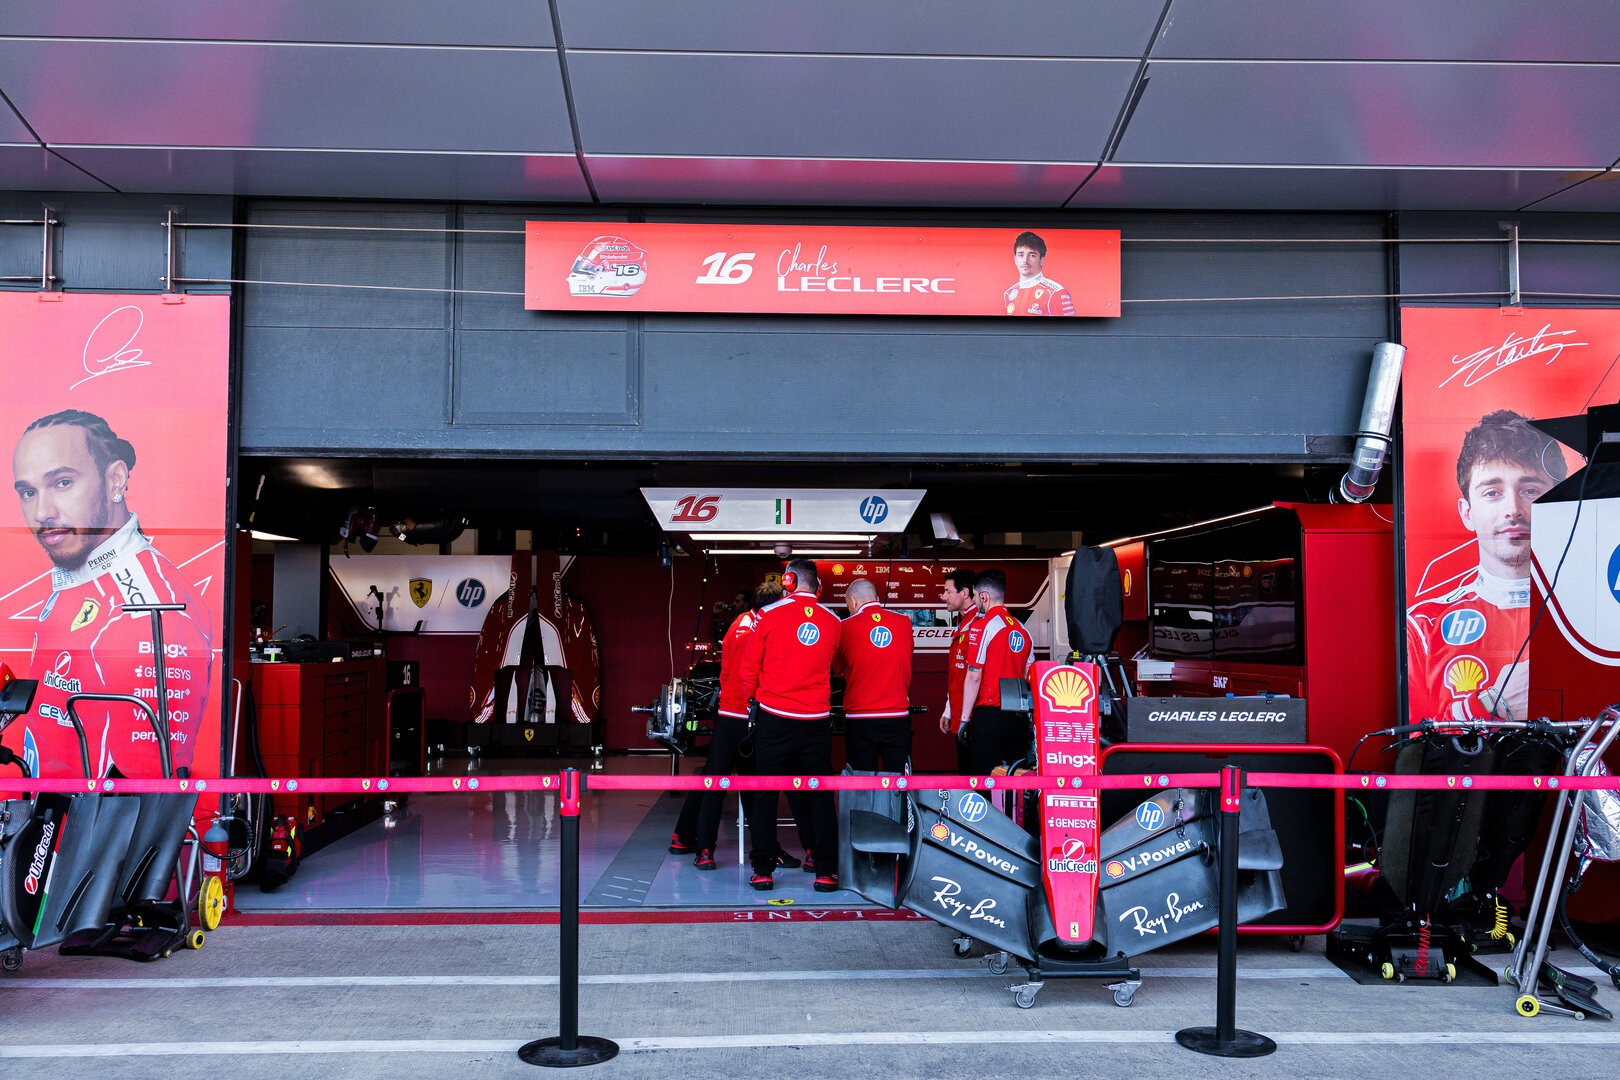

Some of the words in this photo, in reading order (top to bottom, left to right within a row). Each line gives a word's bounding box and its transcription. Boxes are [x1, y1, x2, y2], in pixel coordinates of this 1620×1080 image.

[695, 252, 757, 285] 16
[777, 241, 839, 277] Charles
[578, 284, 595, 293] IBM
[777, 276, 956, 293] LECLERC
[669, 493, 723, 524] 16
[862, 496, 887, 525] hp
[87, 548, 117, 568] PERONI
[875, 566, 890, 574] IBM
[459, 578, 483, 609] hp
[798, 623, 819, 646] hp
[871, 626, 890, 648] hp
[1446, 611, 1481, 646] hp
[1009, 630, 1024, 652] hp
[43, 670, 81, 693] UniCredit
[144, 666, 191, 681] GEESYS
[402, 664, 411, 685] 16
[1148, 711, 1217, 723] CHARLES
[1219, 711, 1287, 723] LECLERC
[131, 731, 188, 745] perpxity
[1044, 721, 1096, 744] IBM
[1046, 752, 1096, 768] Bingx
[959, 794, 986, 823] hp
[1046, 794, 1098, 809] PIRELLI
[1055, 818, 1097, 829] GENESYS
[1139, 800, 1163, 831] hp
[29, 821, 55, 880] UniCredit
[950, 831, 1019, 875] V-Power
[1123, 838, 1192, 872] V-Power
[1049, 858, 1098, 874] UniCredit
[931, 876, 1006, 929] Ray-Ban
[1119, 892, 1204, 937] Ray-Ban
